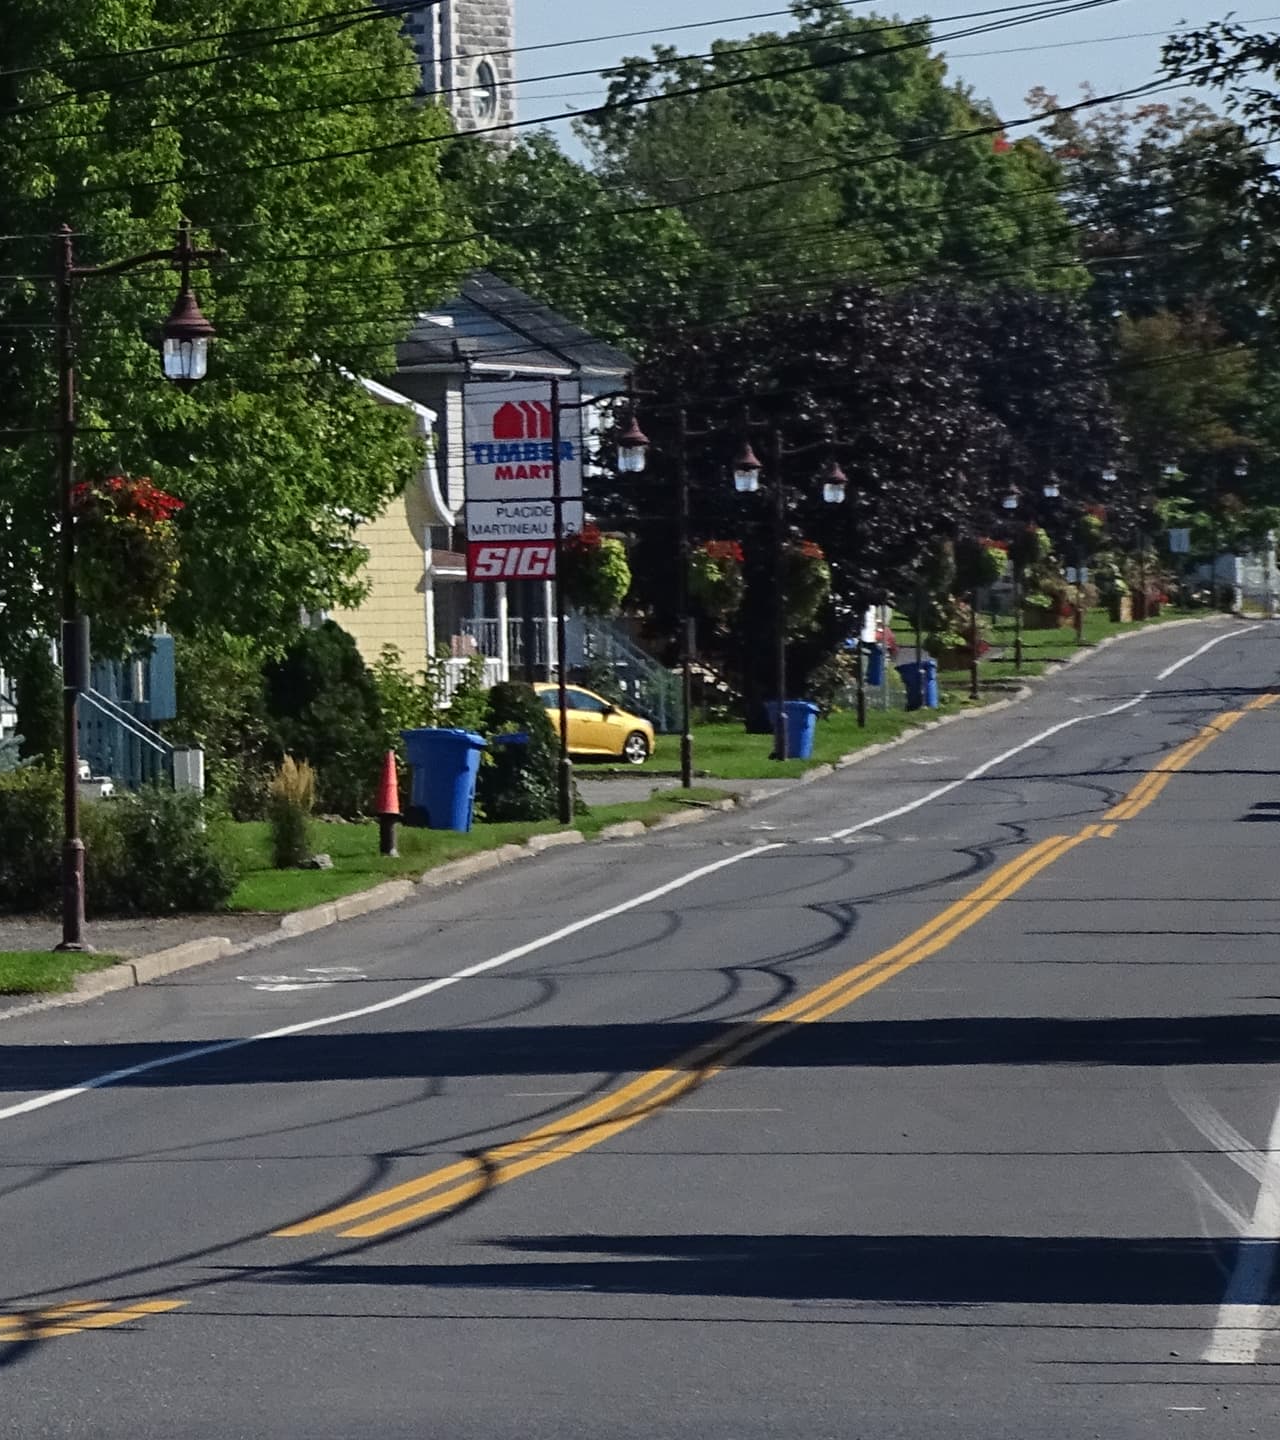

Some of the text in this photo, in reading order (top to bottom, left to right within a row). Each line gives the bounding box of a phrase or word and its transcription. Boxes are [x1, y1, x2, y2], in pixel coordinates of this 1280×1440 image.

[470, 441, 575, 464] TIMBER
[494, 465, 553, 480] MART
[496, 505, 553, 518] PLACIDE
[471, 523, 548, 536] MARTINEAU
[474, 547, 556, 576] SIC
